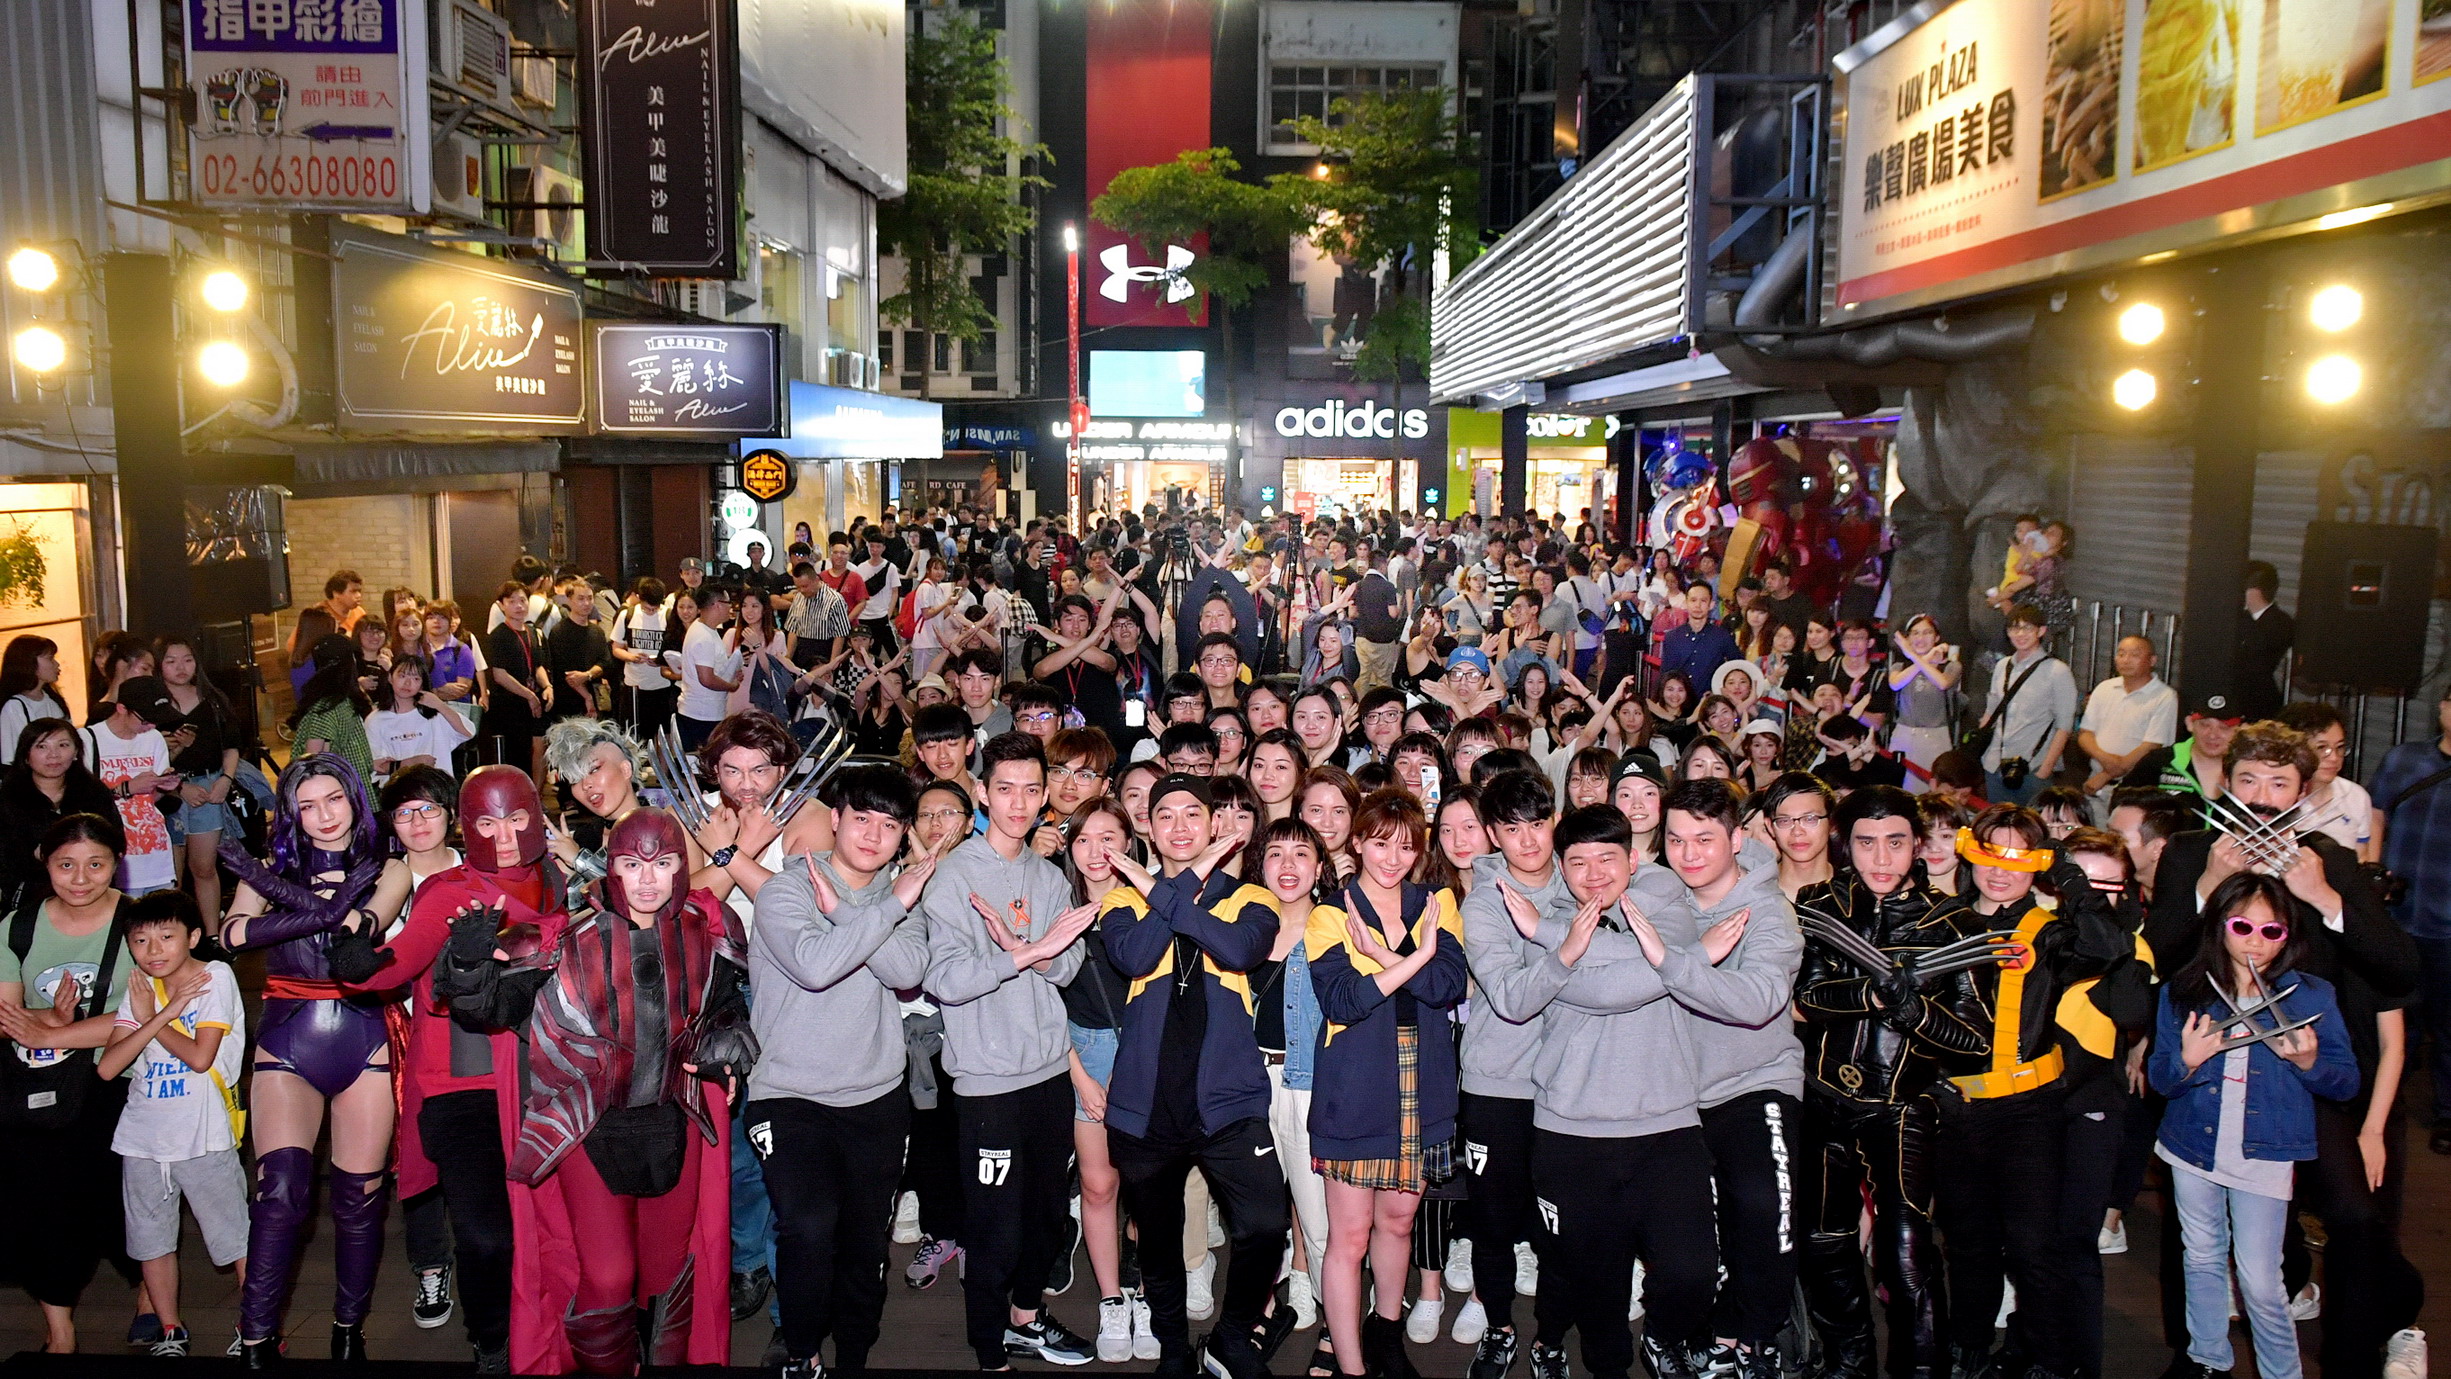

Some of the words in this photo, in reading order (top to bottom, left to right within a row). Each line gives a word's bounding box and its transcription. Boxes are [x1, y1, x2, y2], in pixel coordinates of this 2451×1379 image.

[202, 0, 383, 42] 指甲彩繪
[315, 65, 361, 84] 請由
[700, 48, 710, 92] NAIL
[1897, 70, 1925, 122] LUX
[1928, 40, 1978, 106] PLAZA
[301, 89, 394, 109] 前門進入
[648, 85, 670, 235] 美甲美睫沙龍
[703, 109, 713, 189] EYELASH
[1863, 86, 2016, 214] 樂聲廣場美食
[204, 153, 396, 198] 02-66308080
[706, 193, 716, 249] SALON
[352, 304, 368, 317] NAIL
[353, 323, 385, 337] EYELASH
[354, 342, 378, 353] SALON
[627, 354, 744, 396] 愛麗絲
[628, 399, 647, 407] NAIL
[628, 407, 665, 415] EYELASH
[629, 415, 656, 423] SALON
[147, 1081, 153, 1098] I
[158, 1078, 191, 1099] AM.
[978, 1157, 1011, 1186] 07
[1763, 1101, 1794, 1254] STAYREAL
